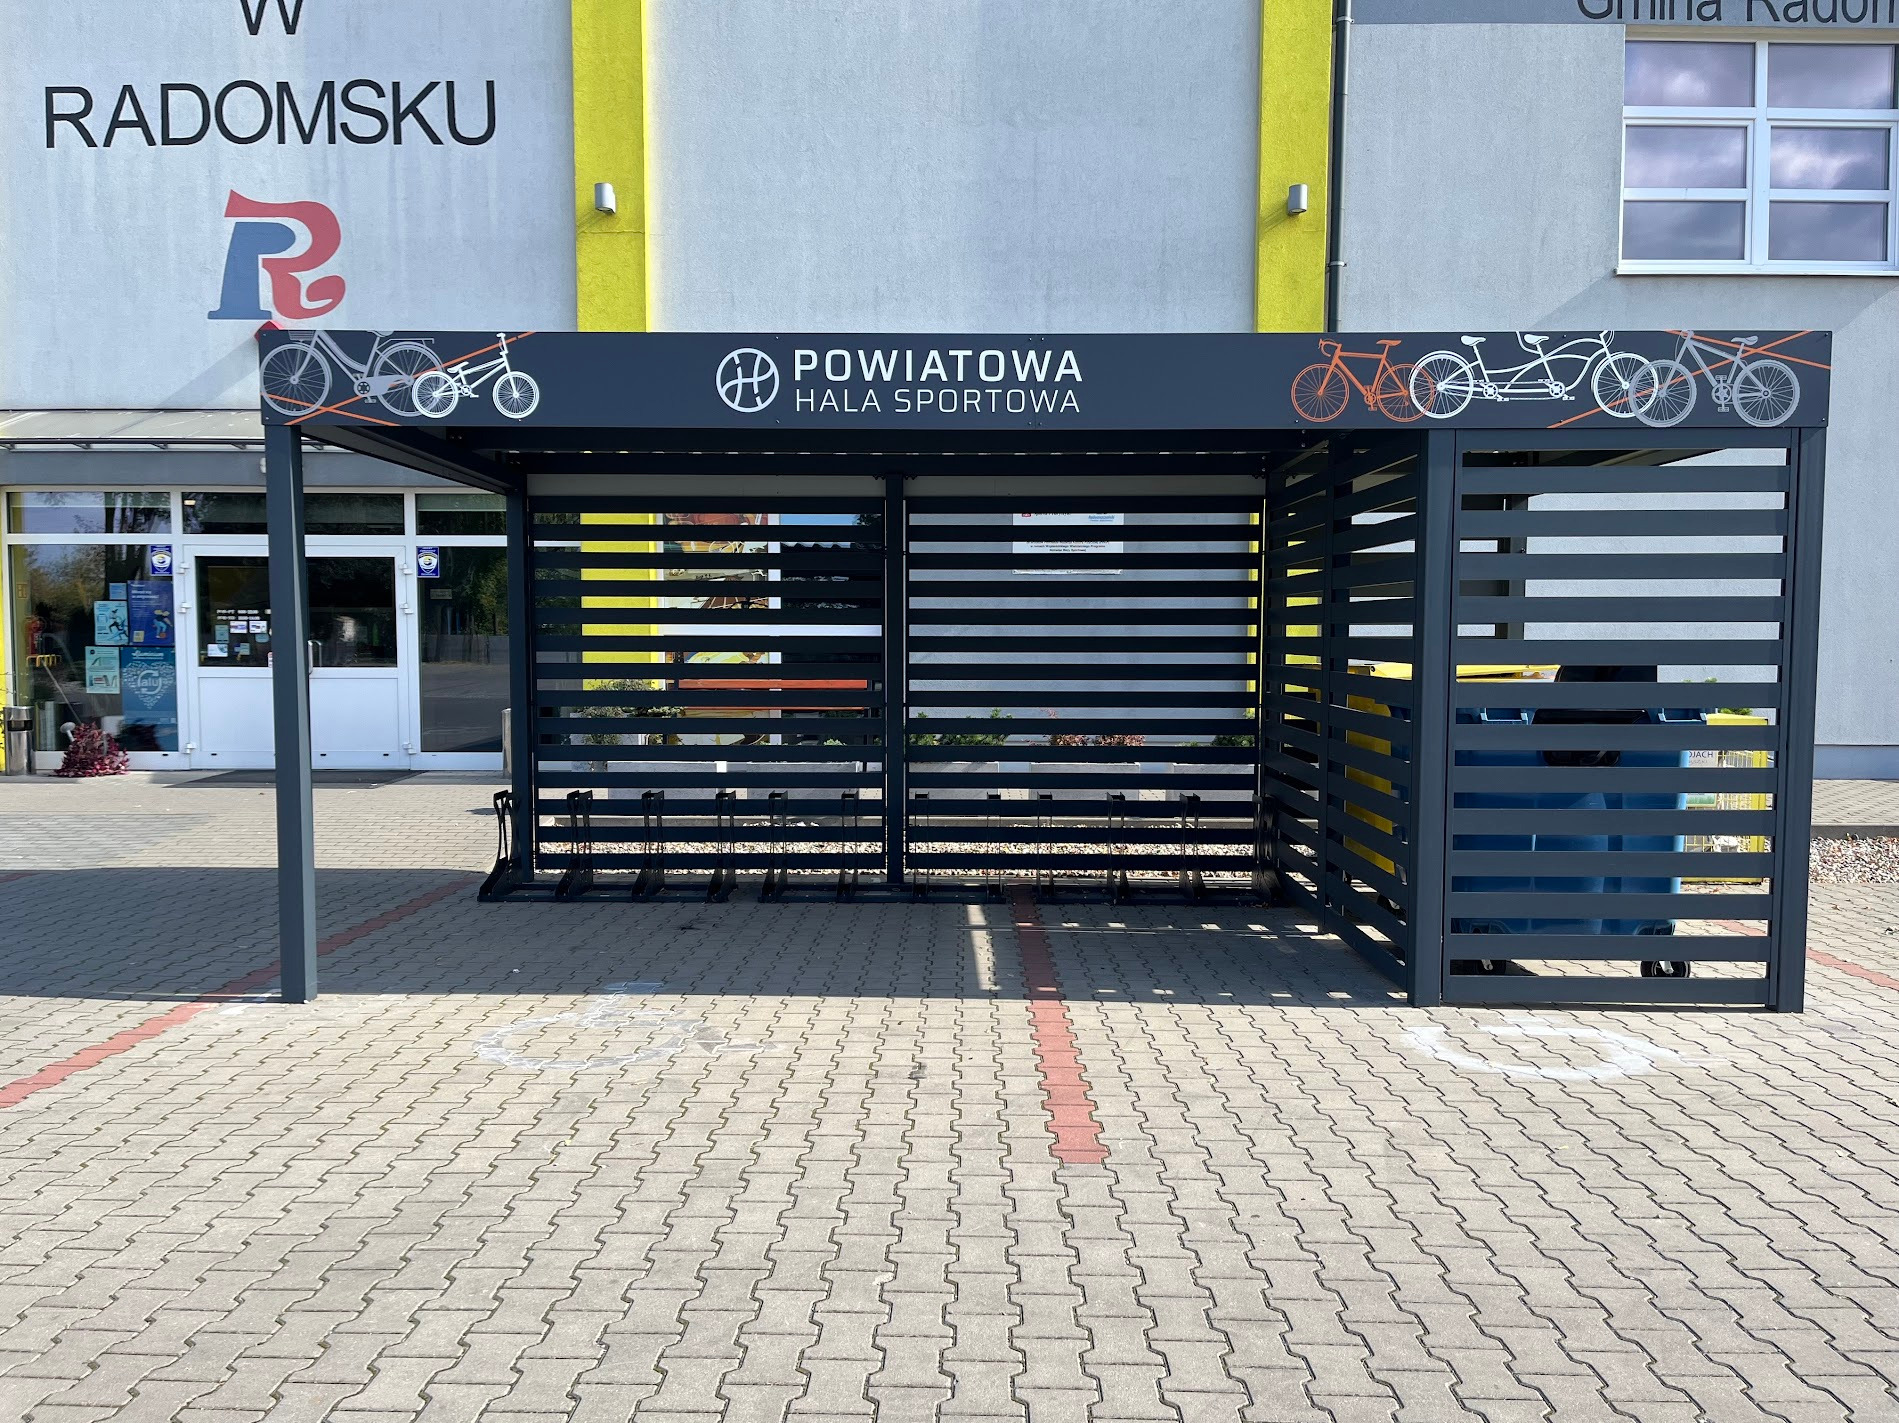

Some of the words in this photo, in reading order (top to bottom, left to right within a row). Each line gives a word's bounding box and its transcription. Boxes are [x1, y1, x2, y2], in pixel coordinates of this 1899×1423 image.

[45, 79, 496, 148] RADOMSKU
[793, 348, 1083, 383] POWIATOWA
[795, 388, 882, 413] HALA
[893, 388, 1081, 413] SPORTOWA
